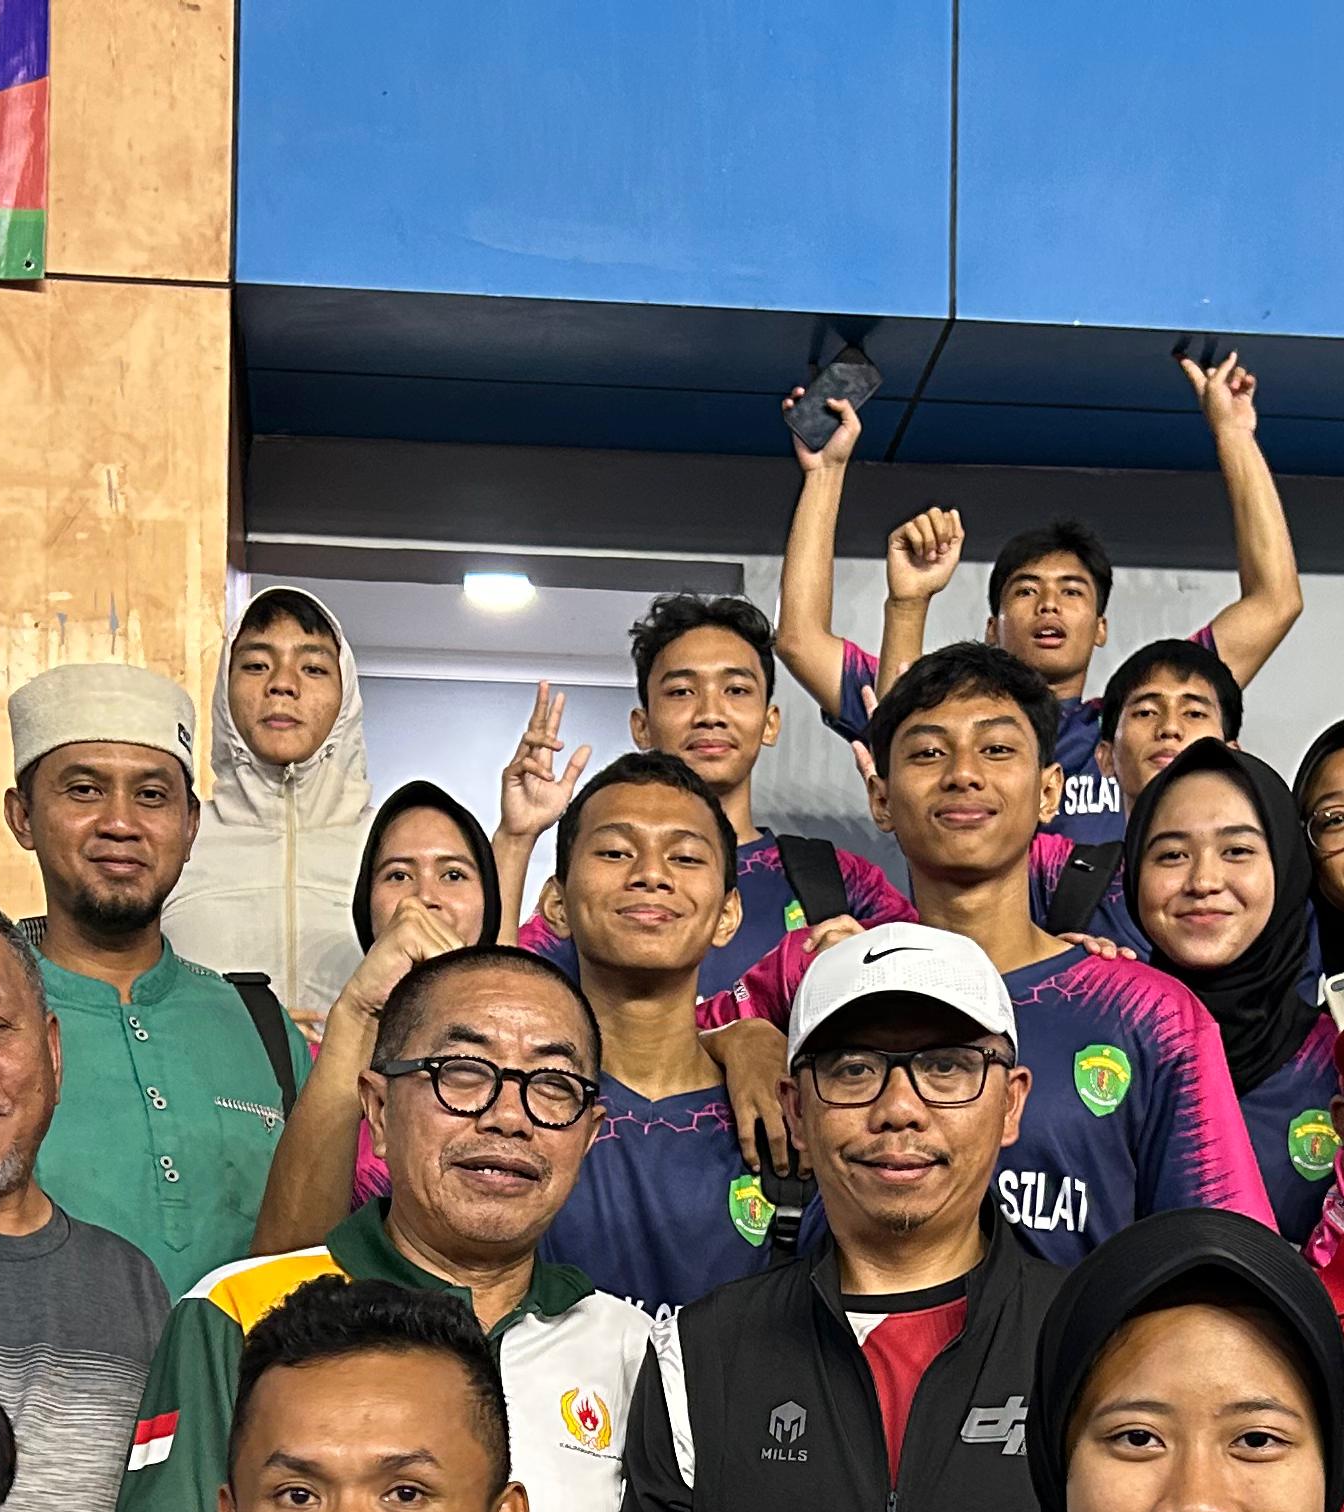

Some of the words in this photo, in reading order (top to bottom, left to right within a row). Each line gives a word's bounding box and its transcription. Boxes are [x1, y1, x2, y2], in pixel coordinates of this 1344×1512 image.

[1064, 775, 1120, 816] SILAT
[998, 1169, 1088, 1233] SILAT
[761, 1447, 808, 1462] MILLS
